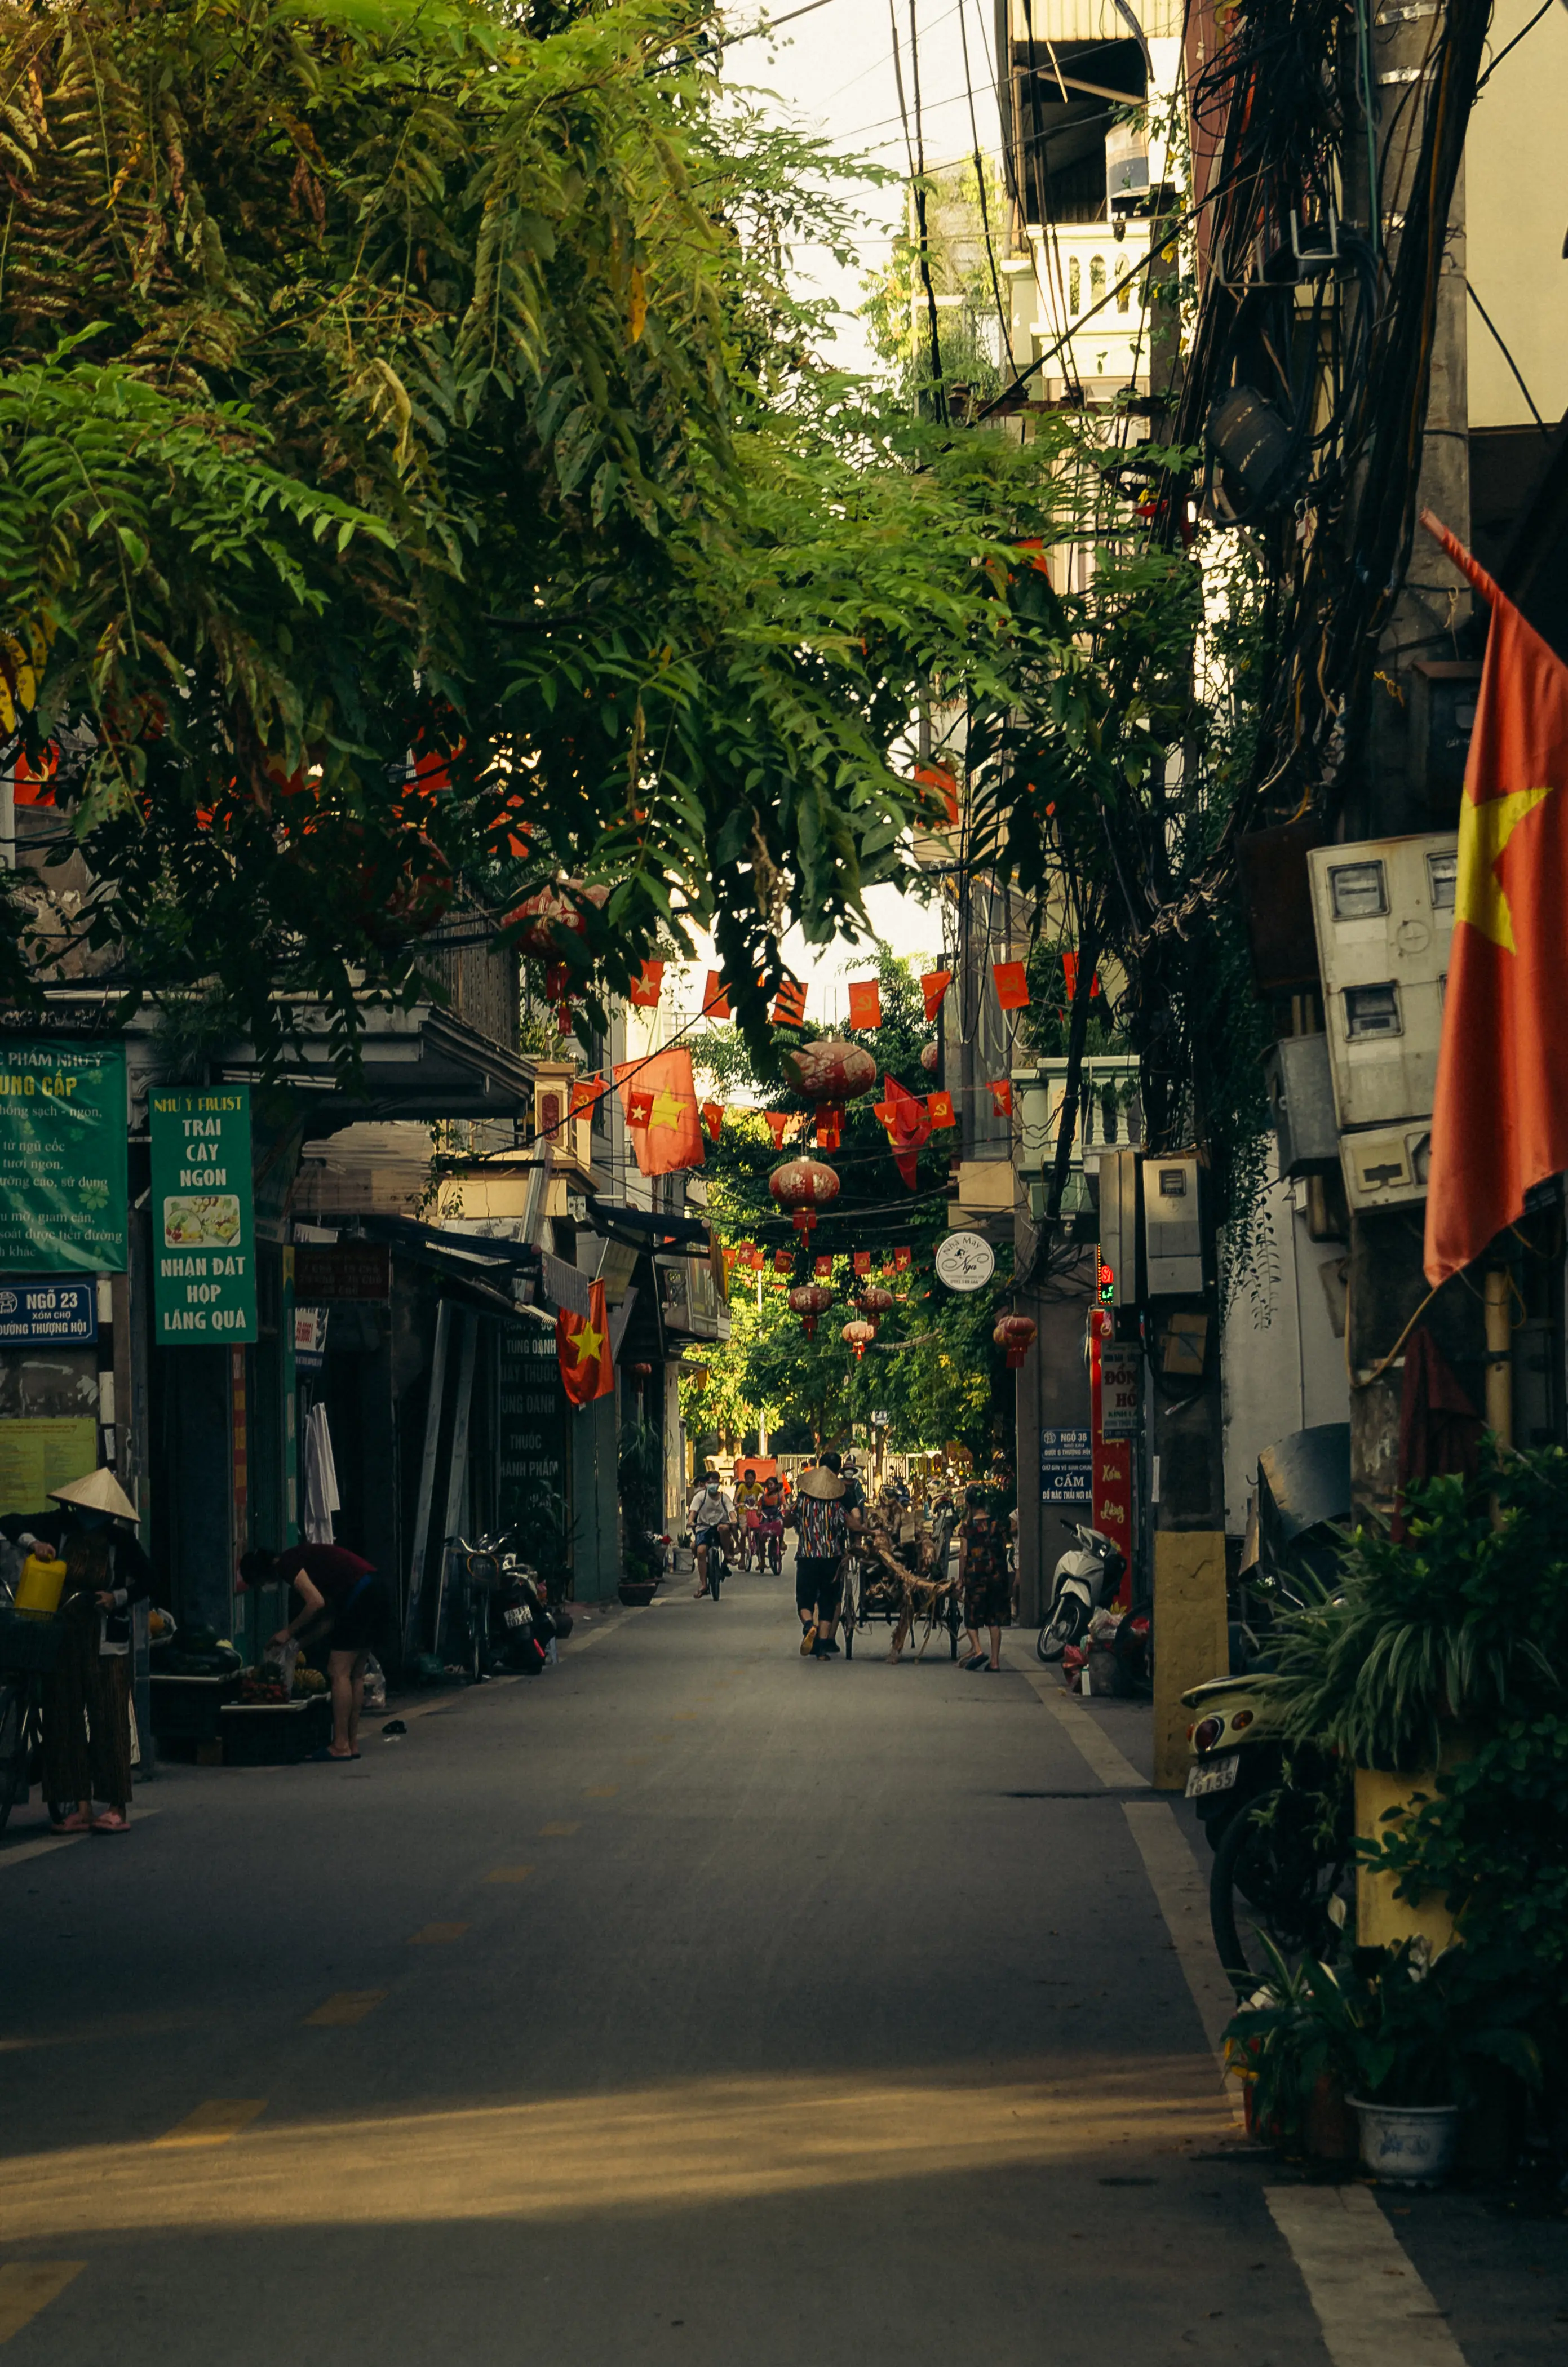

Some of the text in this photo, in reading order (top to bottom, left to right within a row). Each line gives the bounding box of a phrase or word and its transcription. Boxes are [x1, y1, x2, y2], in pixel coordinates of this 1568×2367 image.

[42, 1069, 77, 1096] CẤP
[198, 1095, 242, 1112] FRUIST
[32, 1105, 57, 1119] sạch
[69, 1107, 103, 1120] ngon,
[181, 1116, 222, 1137] TRÁI
[3, 1137, 65, 1154] từ ngũ cốc
[3, 1158, 27, 1169] tươi
[33, 1178, 57, 1188] cao,
[78, 1176, 108, 1191] dụng
[180, 1168, 227, 1187] NGON
[84, 1229, 122, 1244] đường
[161, 1255, 246, 1278] NHẬN ĐẶT
[26, 1289, 78, 1310] NGÕ 23
[187, 1282, 222, 1305] HỘP
[32, 1310, 72, 1320] XÓM CHỢ
[211, 1306, 246, 1331] QUẢ
[31, 1321, 68, 1336] THƯỢNG
[70, 1318, 87, 1335] HỘI
[532, 1338, 556, 1354] OANH
[1104, 1363, 1137, 1385] ĐỒN
[1061, 1430, 1076, 1442] NGÕ
[500, 1459, 526, 1478] HÀNH
[1054, 1471, 1084, 1487] CẤM
